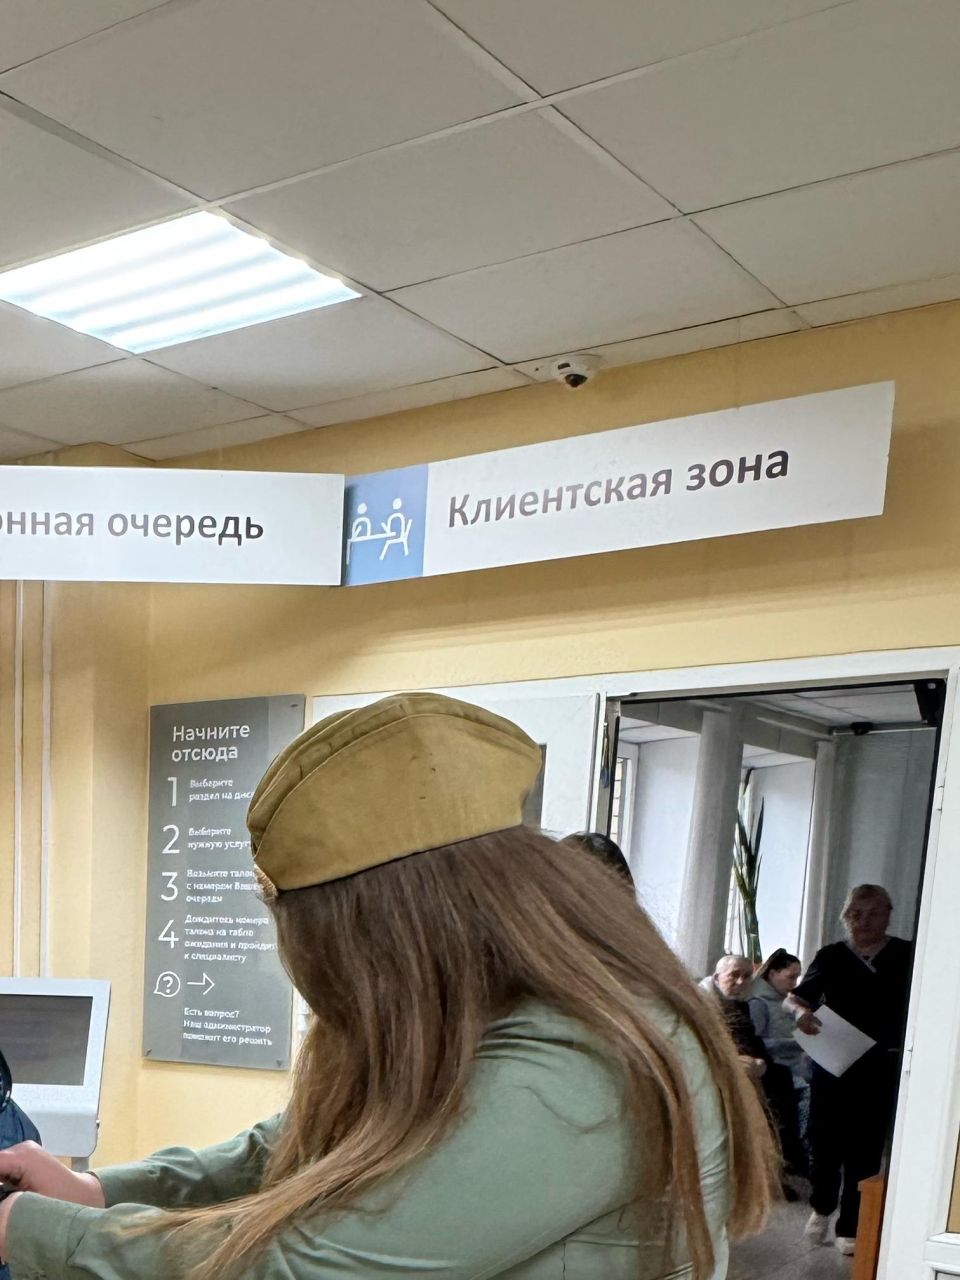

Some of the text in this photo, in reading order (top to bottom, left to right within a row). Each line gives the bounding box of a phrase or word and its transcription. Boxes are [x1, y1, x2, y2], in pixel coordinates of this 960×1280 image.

[448, 449, 790, 528] Клиентская зона
[107, 509, 265, 546] очередь
[172, 724, 251, 742] Начните
[171, 746, 239, 762] отсюда
[189, 778, 234, 789] Выберите
[167, 776, 178, 807] 1
[188, 793, 220, 803] раздел
[188, 826, 232, 837] Выберите
[161, 824, 181, 854] 2
[187, 840, 252, 851] нужную услуг
[160, 871, 179, 902] 3
[184, 914, 234, 925] Дождитесь
[157, 919, 180, 949] 4
[184, 927, 254, 937] талона на табло
[230, 941, 236, 949] и
[191, 952, 248, 963] специалисту
[183, 1007, 240, 1019] Есть вопрос?
[183, 1019, 272, 1034] Наш администратор
[222, 1035, 238, 1044] его
[238, 1036, 273, 1046] решить
